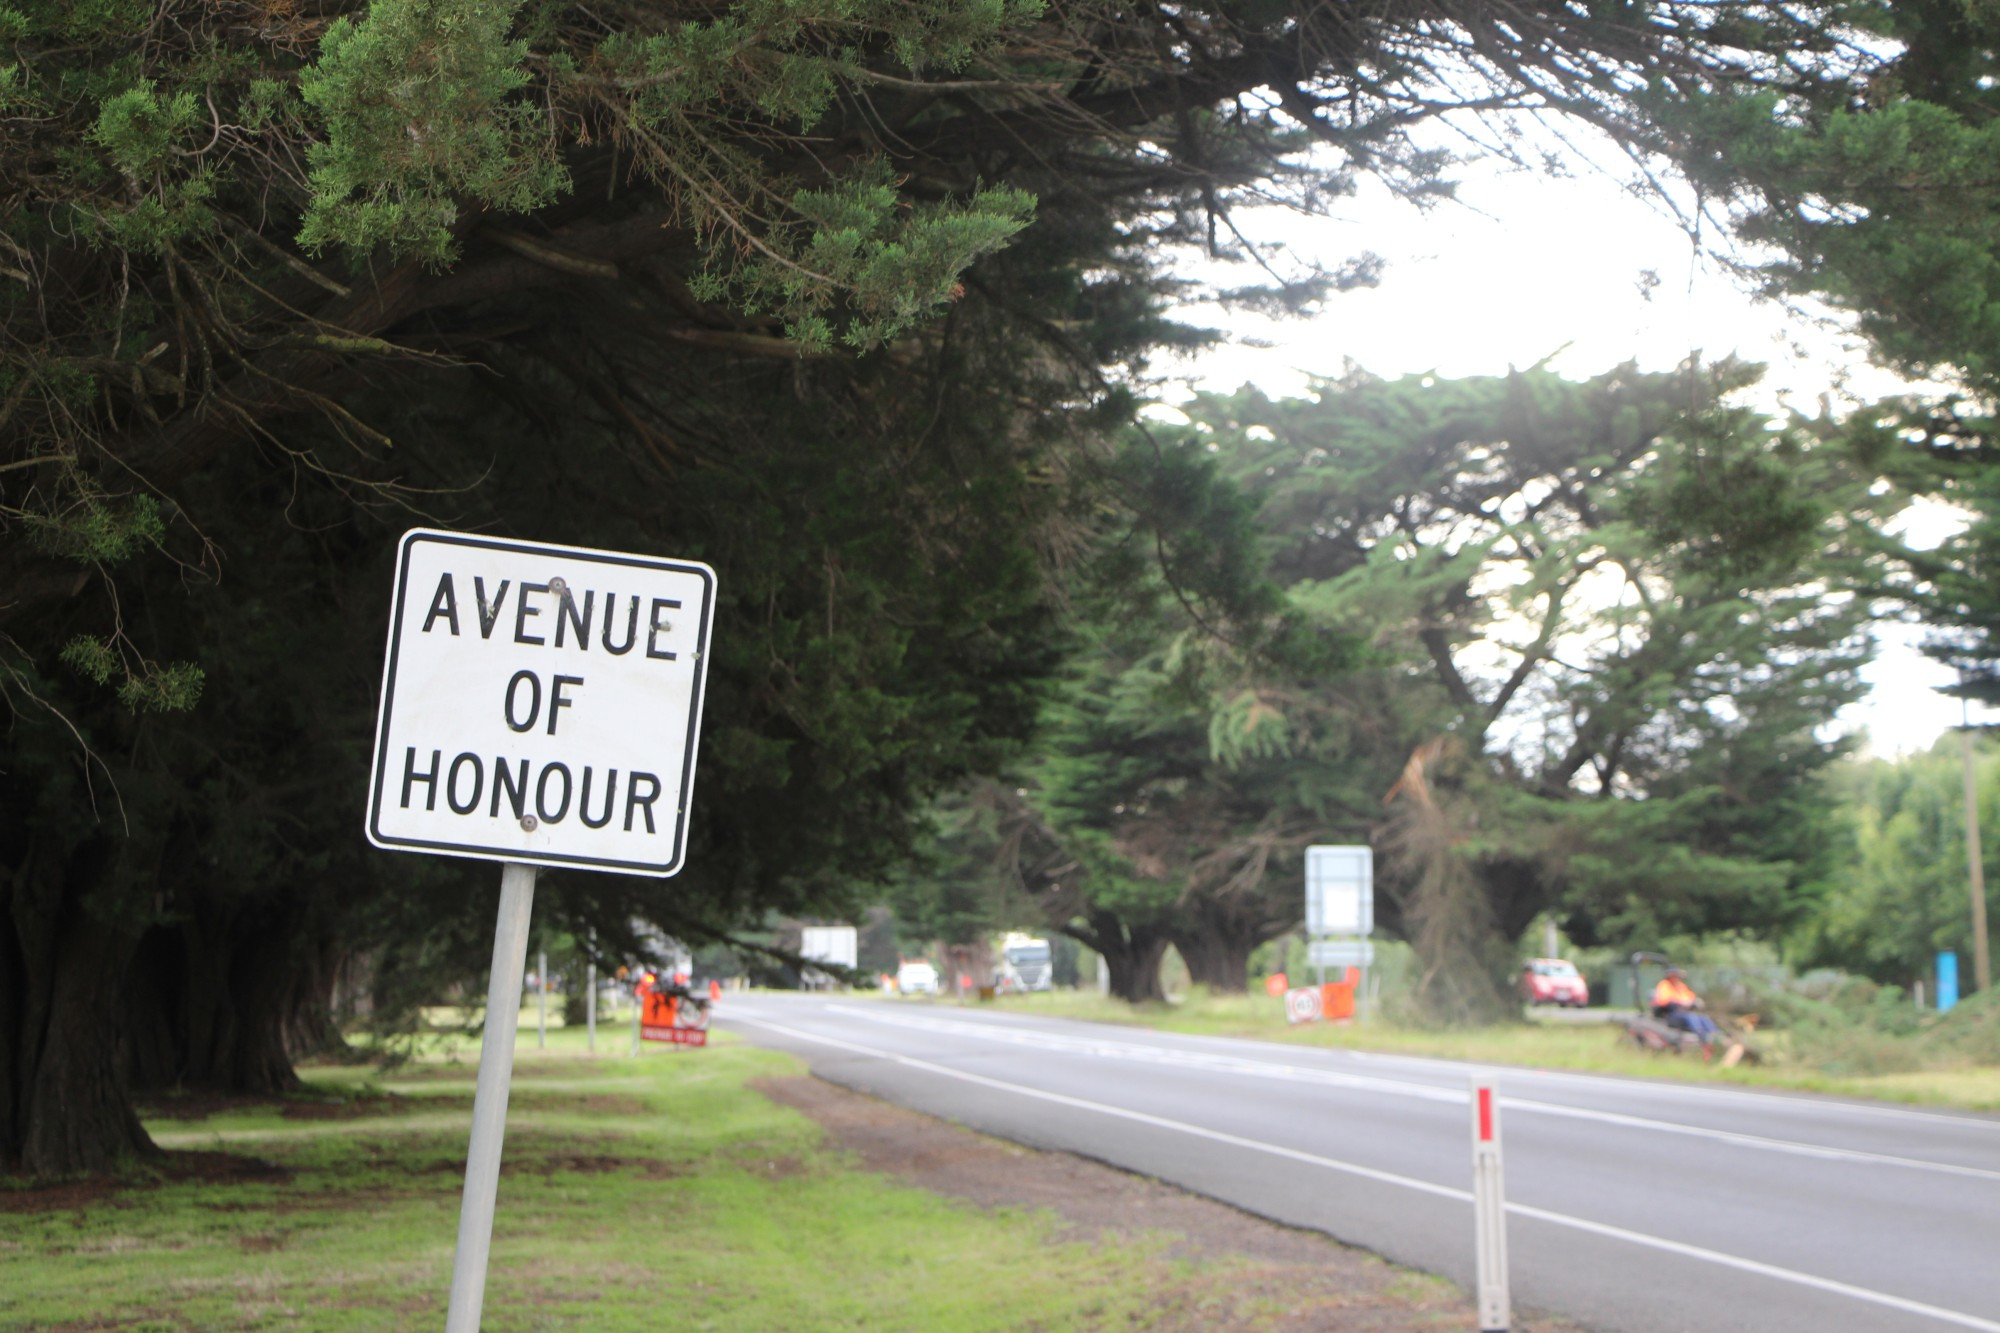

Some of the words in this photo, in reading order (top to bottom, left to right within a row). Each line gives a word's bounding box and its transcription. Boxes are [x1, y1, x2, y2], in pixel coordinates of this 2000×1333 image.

[422, 572, 682, 661] AVENUE
[504, 669, 584, 736] OF
[400, 746, 662, 835] HONOUR
